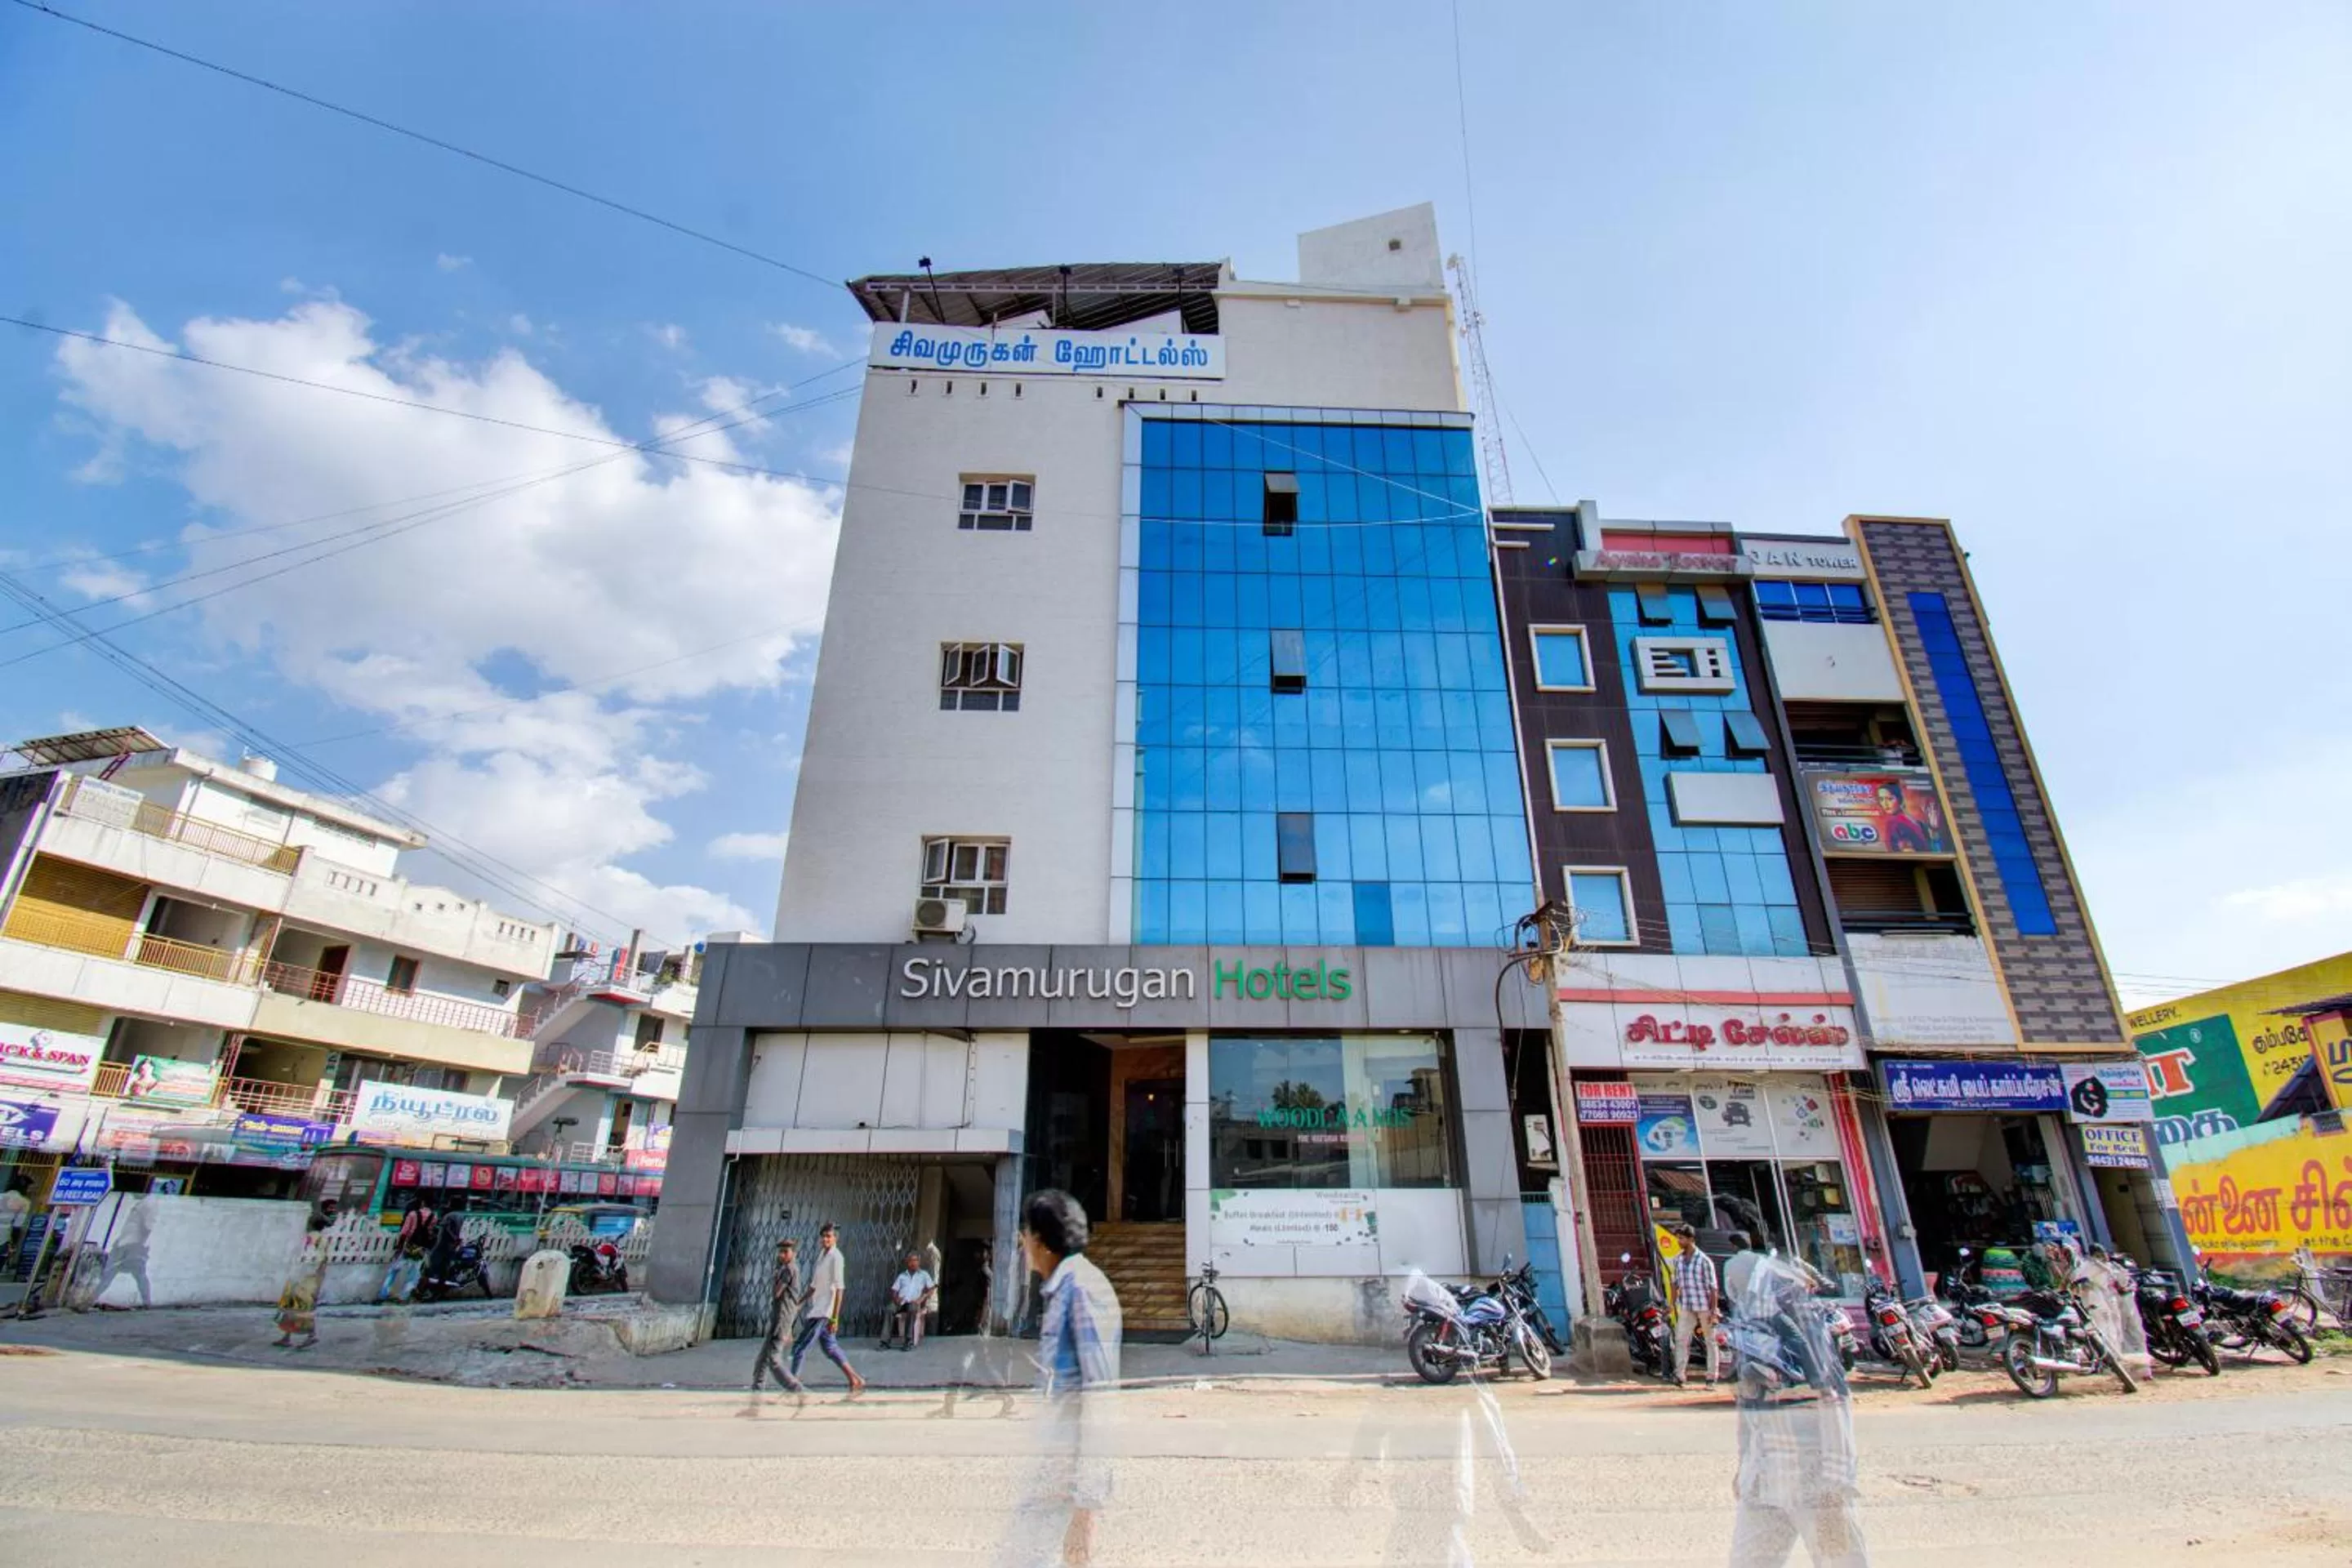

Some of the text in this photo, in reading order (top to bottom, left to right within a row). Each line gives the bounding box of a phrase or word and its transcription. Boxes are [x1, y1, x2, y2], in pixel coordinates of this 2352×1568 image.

[889, 329, 1209, 372] சிவமுருகன் ஹோட்டல்ஸ்
[1807, 555, 1859, 569] TOWER
[1833, 822, 1876, 841] abc
[900, 958, 1352, 1009] Sivamurugan Hotels
[1627, 1013, 1716, 1051] சிட்டி
[48, 1049, 91, 1065] SPAN
[1579, 1084, 1633, 1098] FOR RENT
[2084, 1129, 2140, 1143] OFFICE
